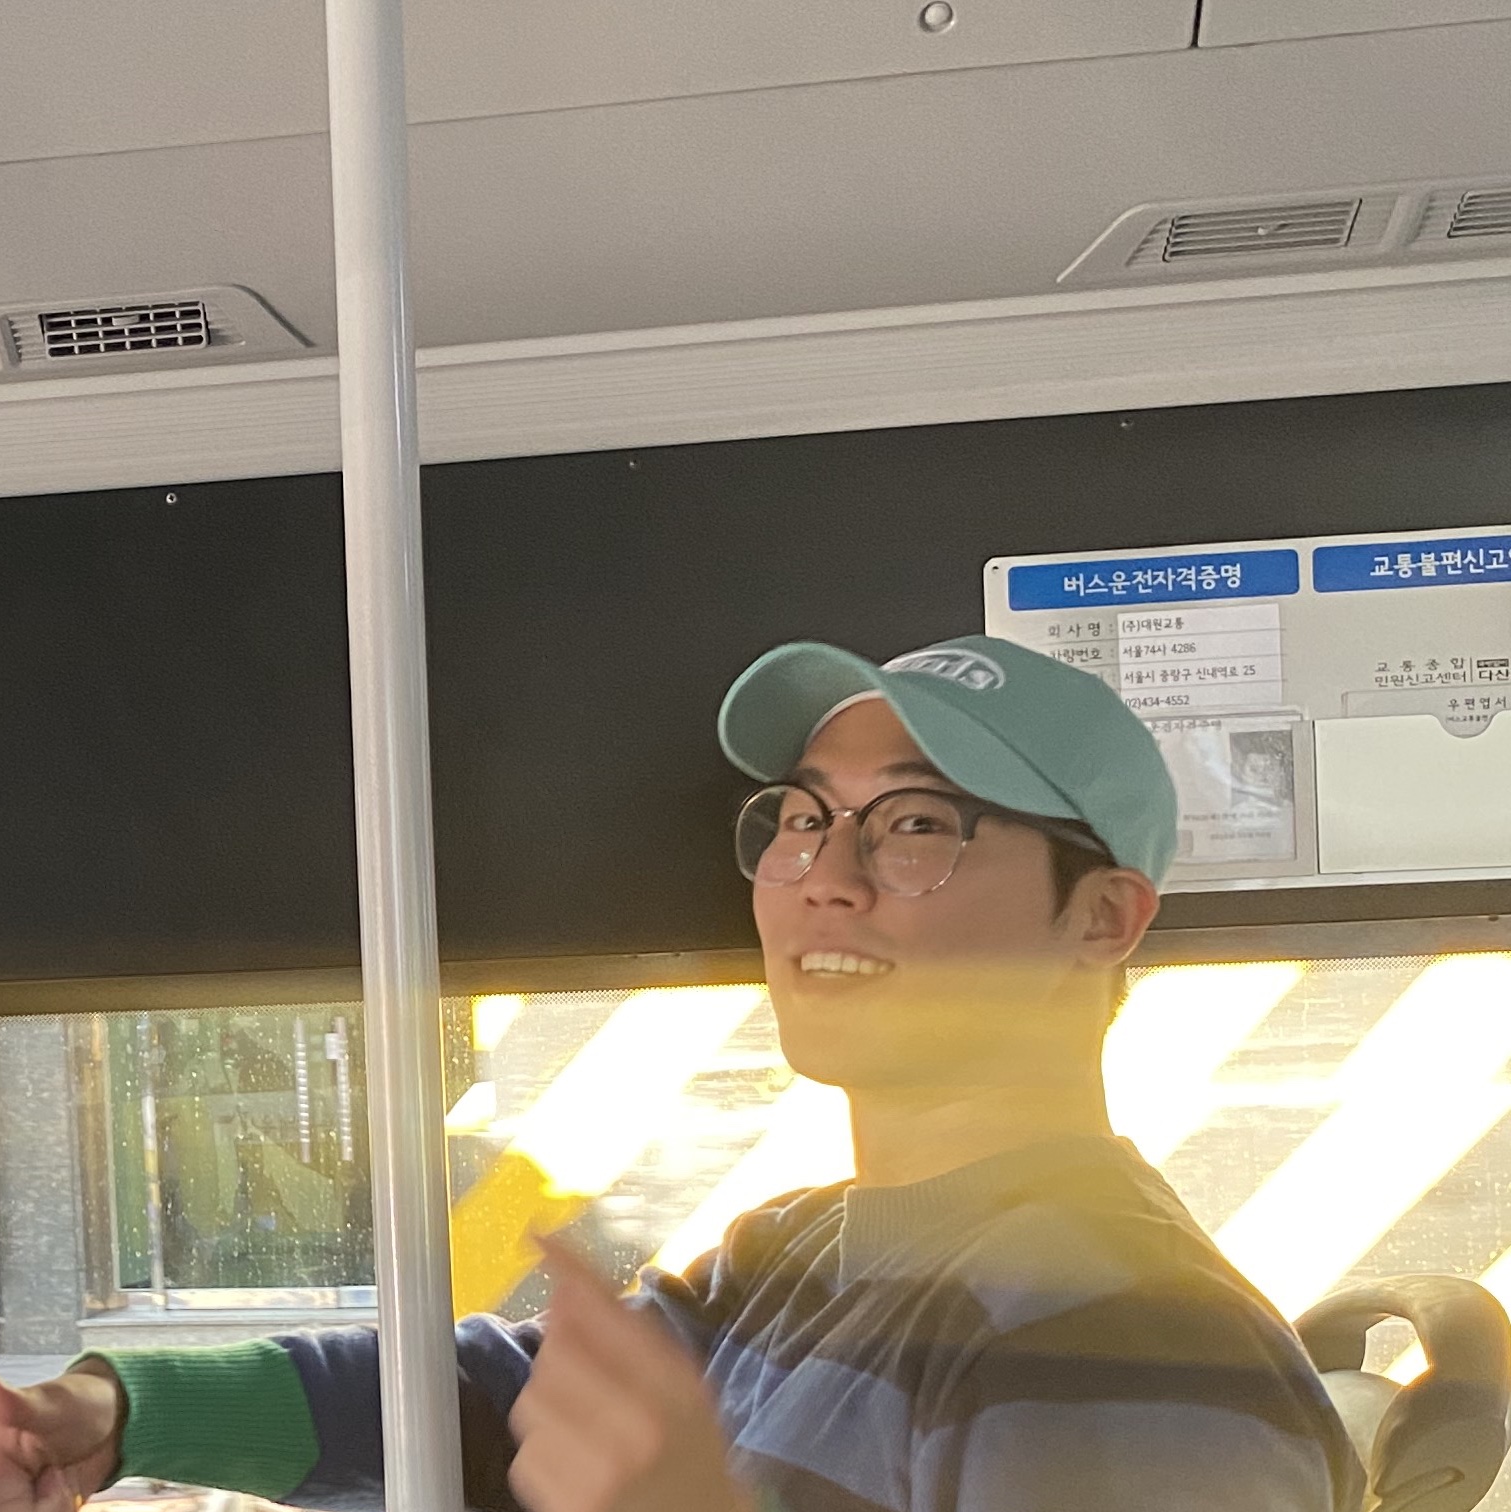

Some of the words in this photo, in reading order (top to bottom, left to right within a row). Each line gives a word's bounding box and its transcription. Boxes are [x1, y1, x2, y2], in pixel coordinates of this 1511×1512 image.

[1369, 549, 1511, 579] 교통불편신고
[1063, 563, 1242, 597] 버스운전자격증명
[1170, 642, 1197, 654] 4286
[1124, 669, 1156, 685] 서울시
[1242, 664, 1257, 677] 25
